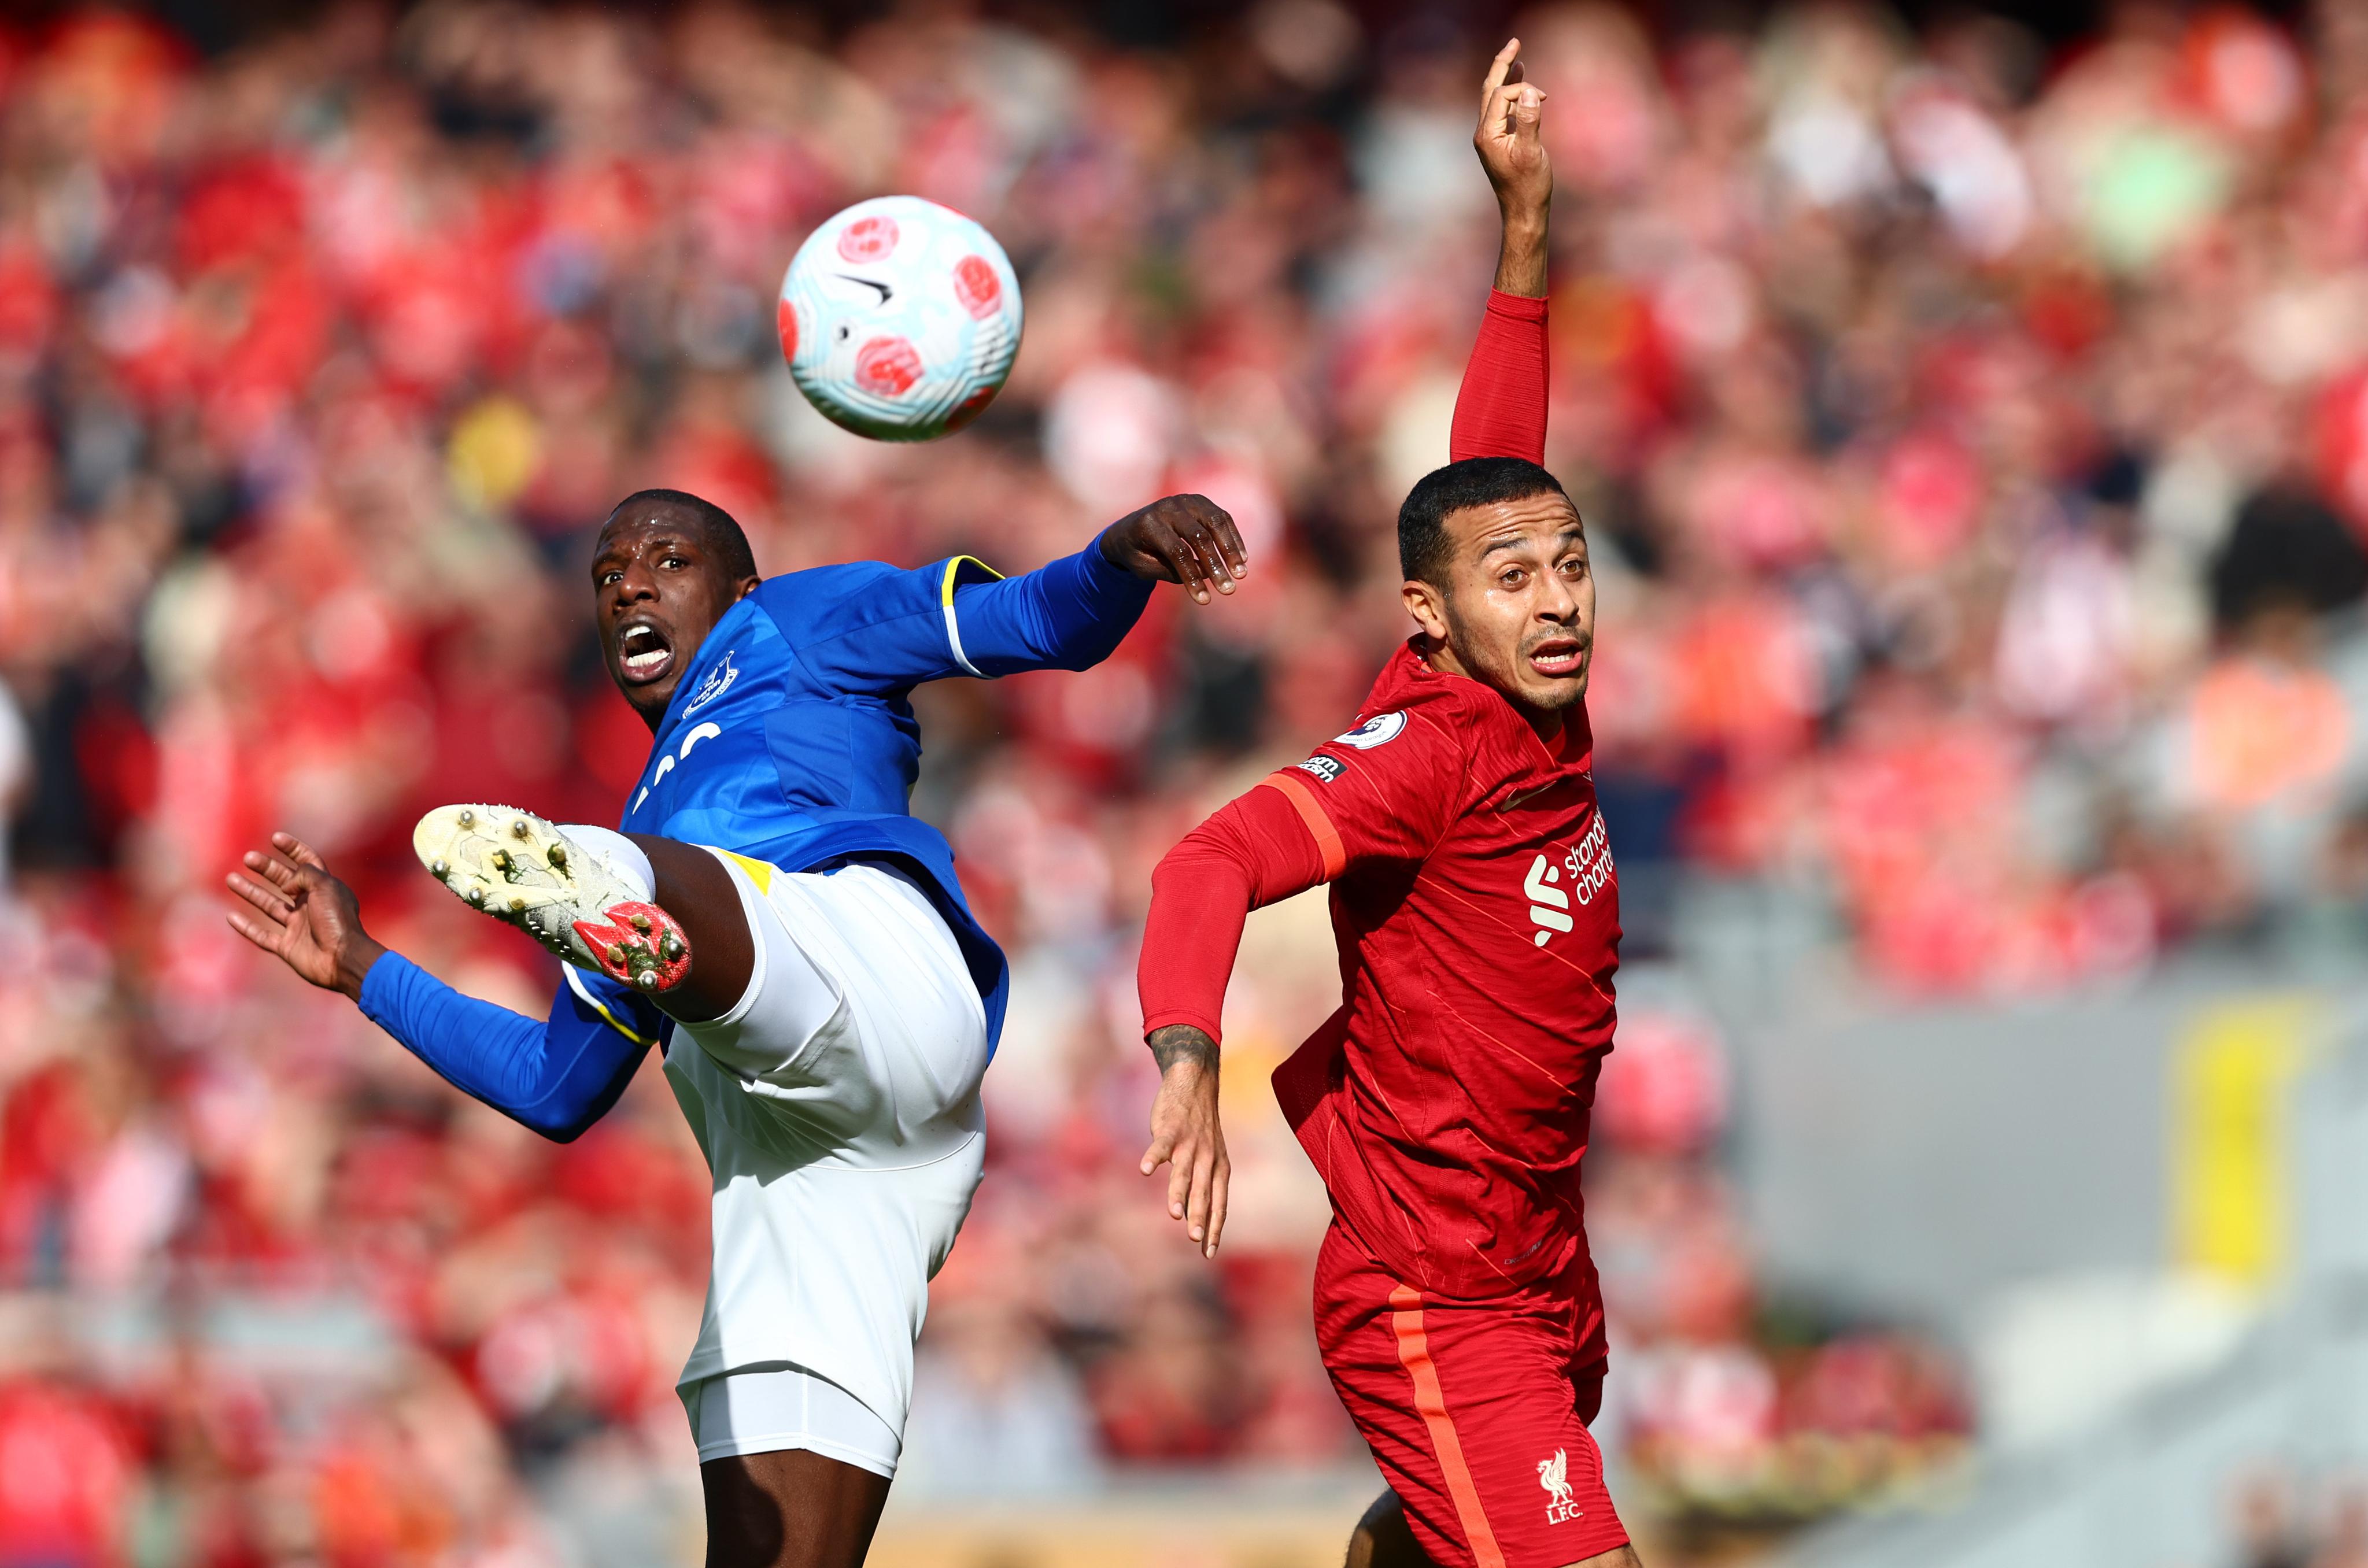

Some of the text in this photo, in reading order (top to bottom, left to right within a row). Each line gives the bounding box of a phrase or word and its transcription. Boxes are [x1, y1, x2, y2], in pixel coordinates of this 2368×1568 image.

[1564, 804, 1605, 879] standa
[1576, 844, 1613, 905] charte
[1546, 1503, 1584, 1525] L.F.C.
